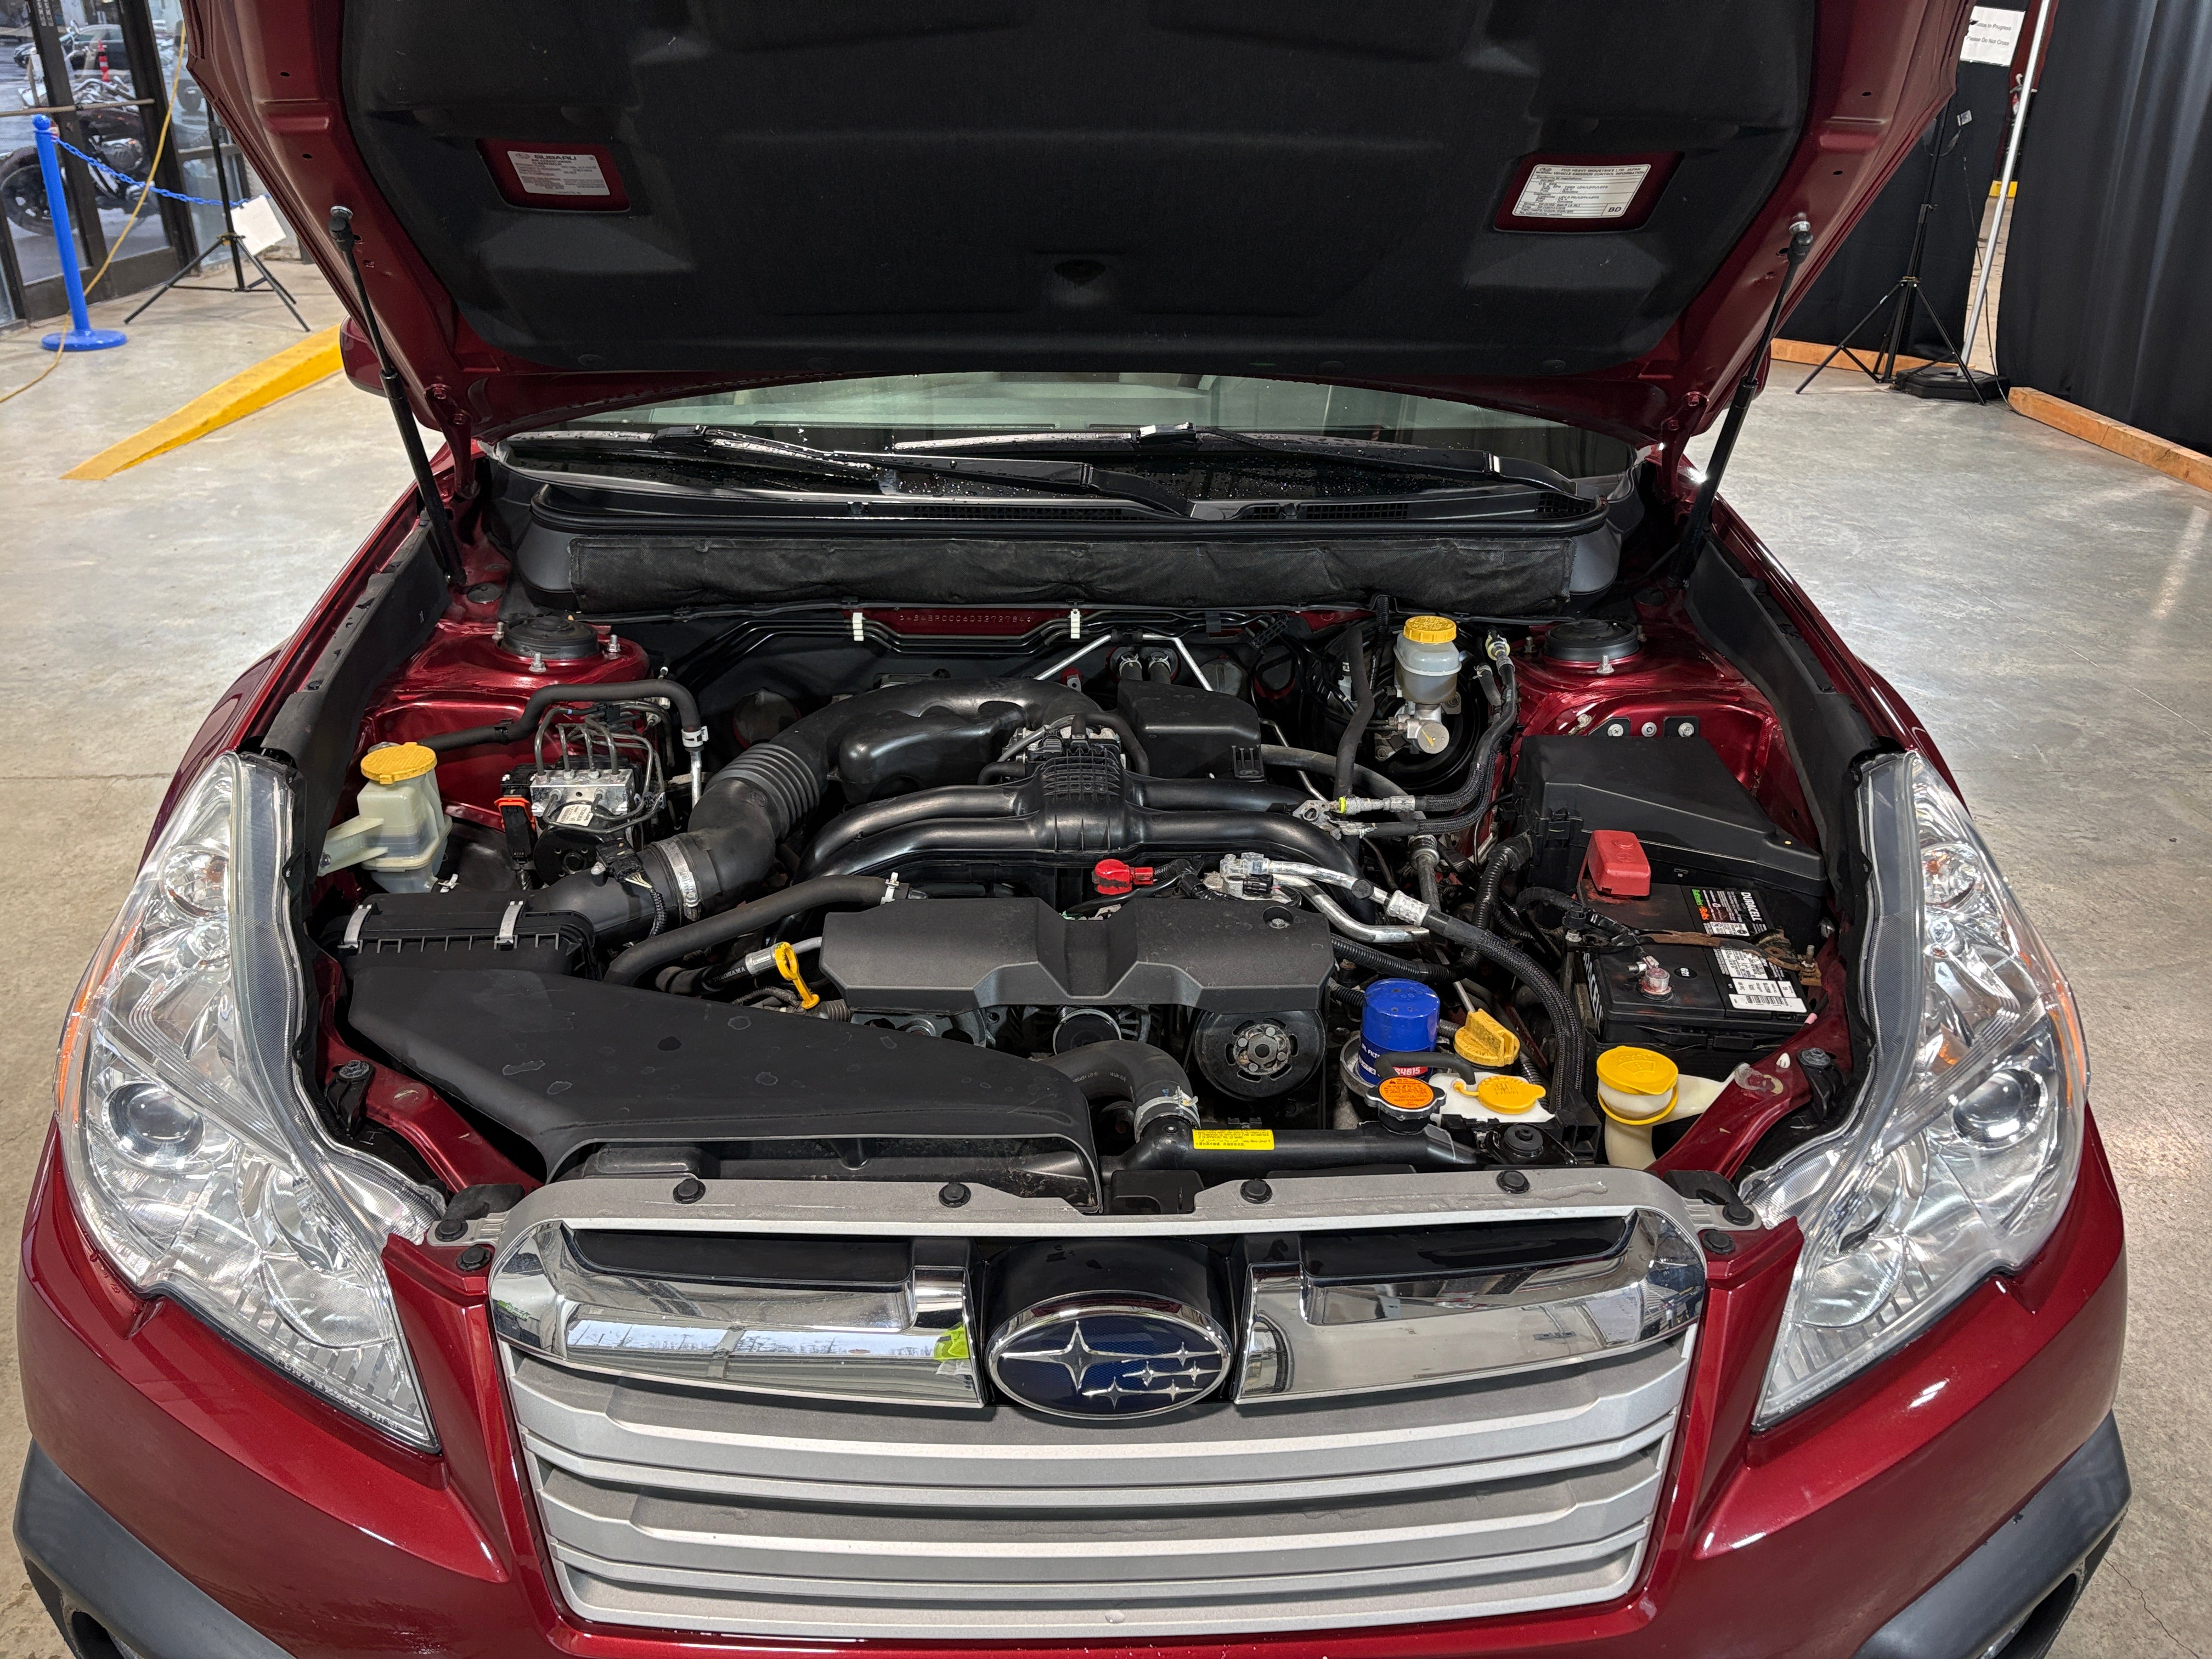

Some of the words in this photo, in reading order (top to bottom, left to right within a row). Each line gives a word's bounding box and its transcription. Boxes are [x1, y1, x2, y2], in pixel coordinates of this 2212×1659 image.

[1741, 891, 1762, 922] DURACELL
[712, 967, 746, 983] YOKOHAMA
[1680, 968, 1690, 977] 621
